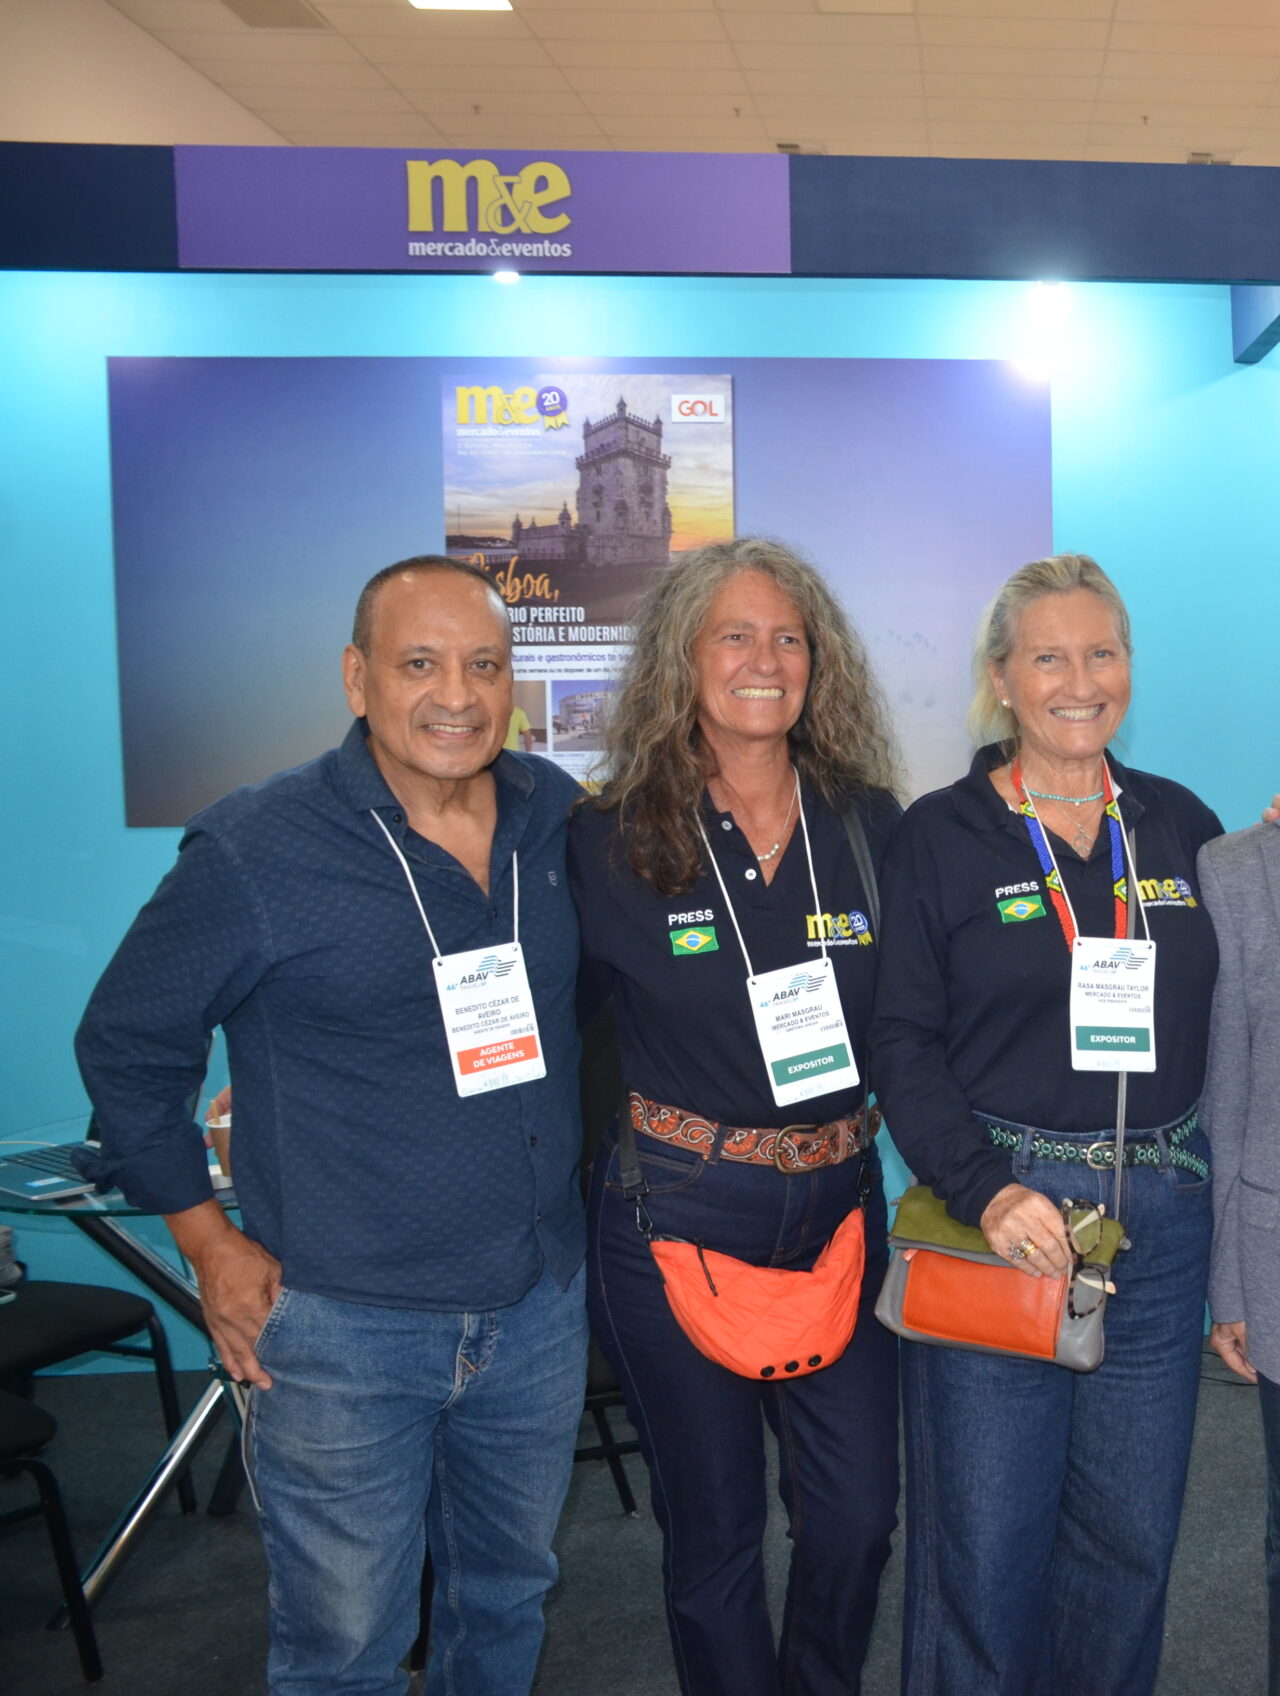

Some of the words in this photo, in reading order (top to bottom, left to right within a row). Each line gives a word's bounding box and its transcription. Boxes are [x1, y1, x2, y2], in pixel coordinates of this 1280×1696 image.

[406, 159, 572, 234] m&e
[408, 238, 572, 257] mercado&eventos
[456, 386, 541, 425] m&e
[542, 391, 560, 406] 20
[678, 400, 719, 417] GOL
[530, 607, 585, 623] PERFEITO
[512, 623, 556, 642] STÓRIA
[558, 627, 565, 642] E
[545, 652, 606, 663] gastronômicos
[995, 881, 1040, 899] PRESS
[668, 909, 714, 926] PRESS
[806, 913, 853, 939] m&e
[1093, 960, 1120, 969] ABAV
[460, 971, 489, 985] ABAV
[772, 987, 801, 1001] ABAV
[455, 1003, 487, 1015] BENEDITO
[488, 998, 510, 1009] CÉZAR
[478, 1009, 501, 1019] AVEIRO
[775, 1013, 791, 1022] MARI
[792, 1004, 823, 1017] MASGRAU
[452, 1022, 480, 1034] BENEDITO
[771, 1019, 799, 1031] MERCADO
[804, 1011, 830, 1022] EVENTOS
[1090, 1034, 1136, 1044] EXPOSITOR
[480, 1042, 515, 1056] AGENTE
[473, 1058, 486, 1068] DE
[486, 1051, 525, 1065] VIAGENS
[788, 1055, 835, 1075] EXPOSITOR
